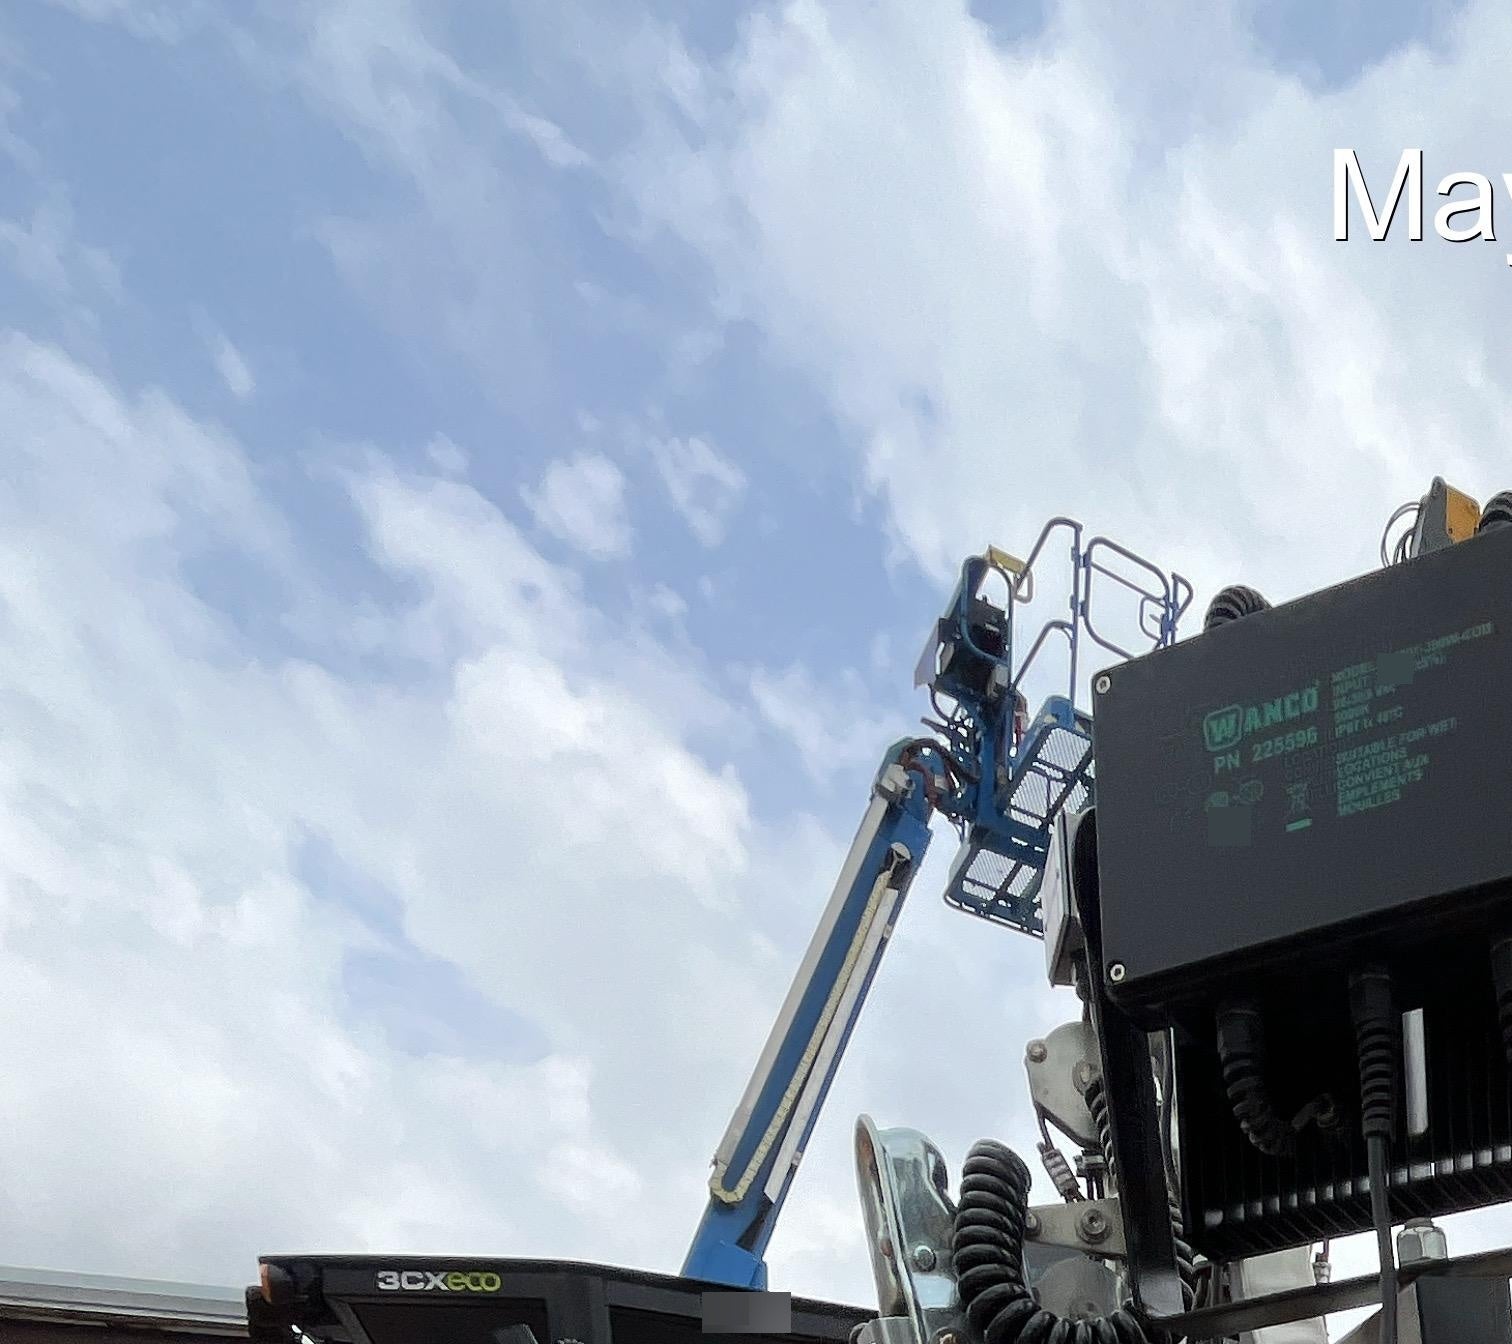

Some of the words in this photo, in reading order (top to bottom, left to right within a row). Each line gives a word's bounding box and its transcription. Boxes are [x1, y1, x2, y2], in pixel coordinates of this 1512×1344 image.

[1206, 685, 1319, 744] WANCO
[1214, 752, 1240, 774] PN
[377, 1270, 502, 1293] 3CXeco
